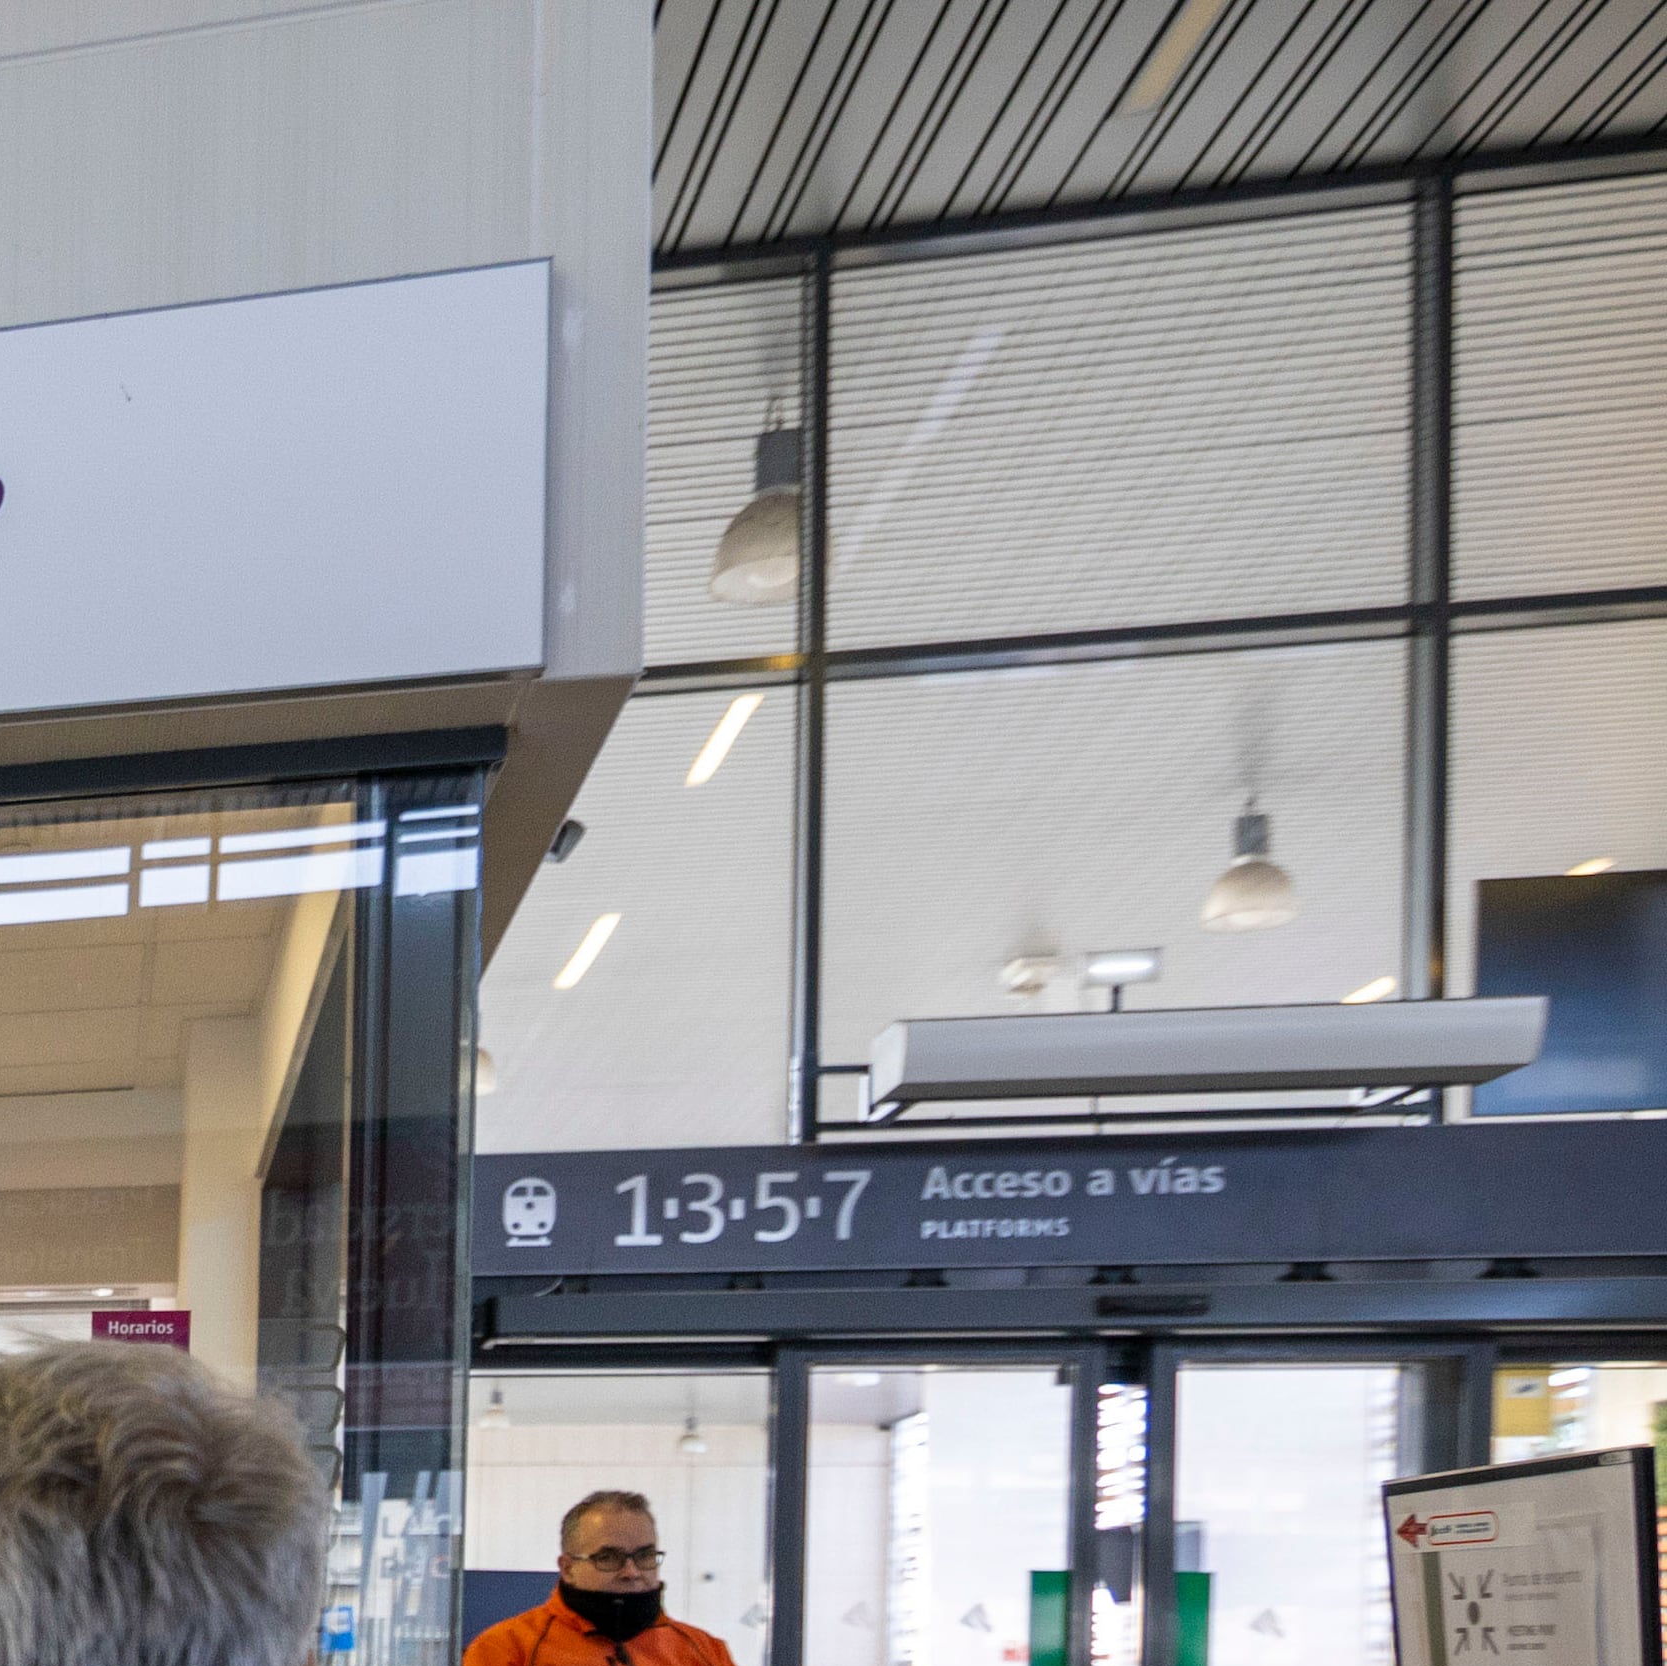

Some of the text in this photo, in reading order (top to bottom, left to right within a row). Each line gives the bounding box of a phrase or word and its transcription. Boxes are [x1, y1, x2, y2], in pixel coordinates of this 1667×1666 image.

[920, 1157, 1227, 1200] Acceso a vías
[920, 1218, 1070, 1240] PLATFORMS
[108, 1320, 174, 1335] Horarios
